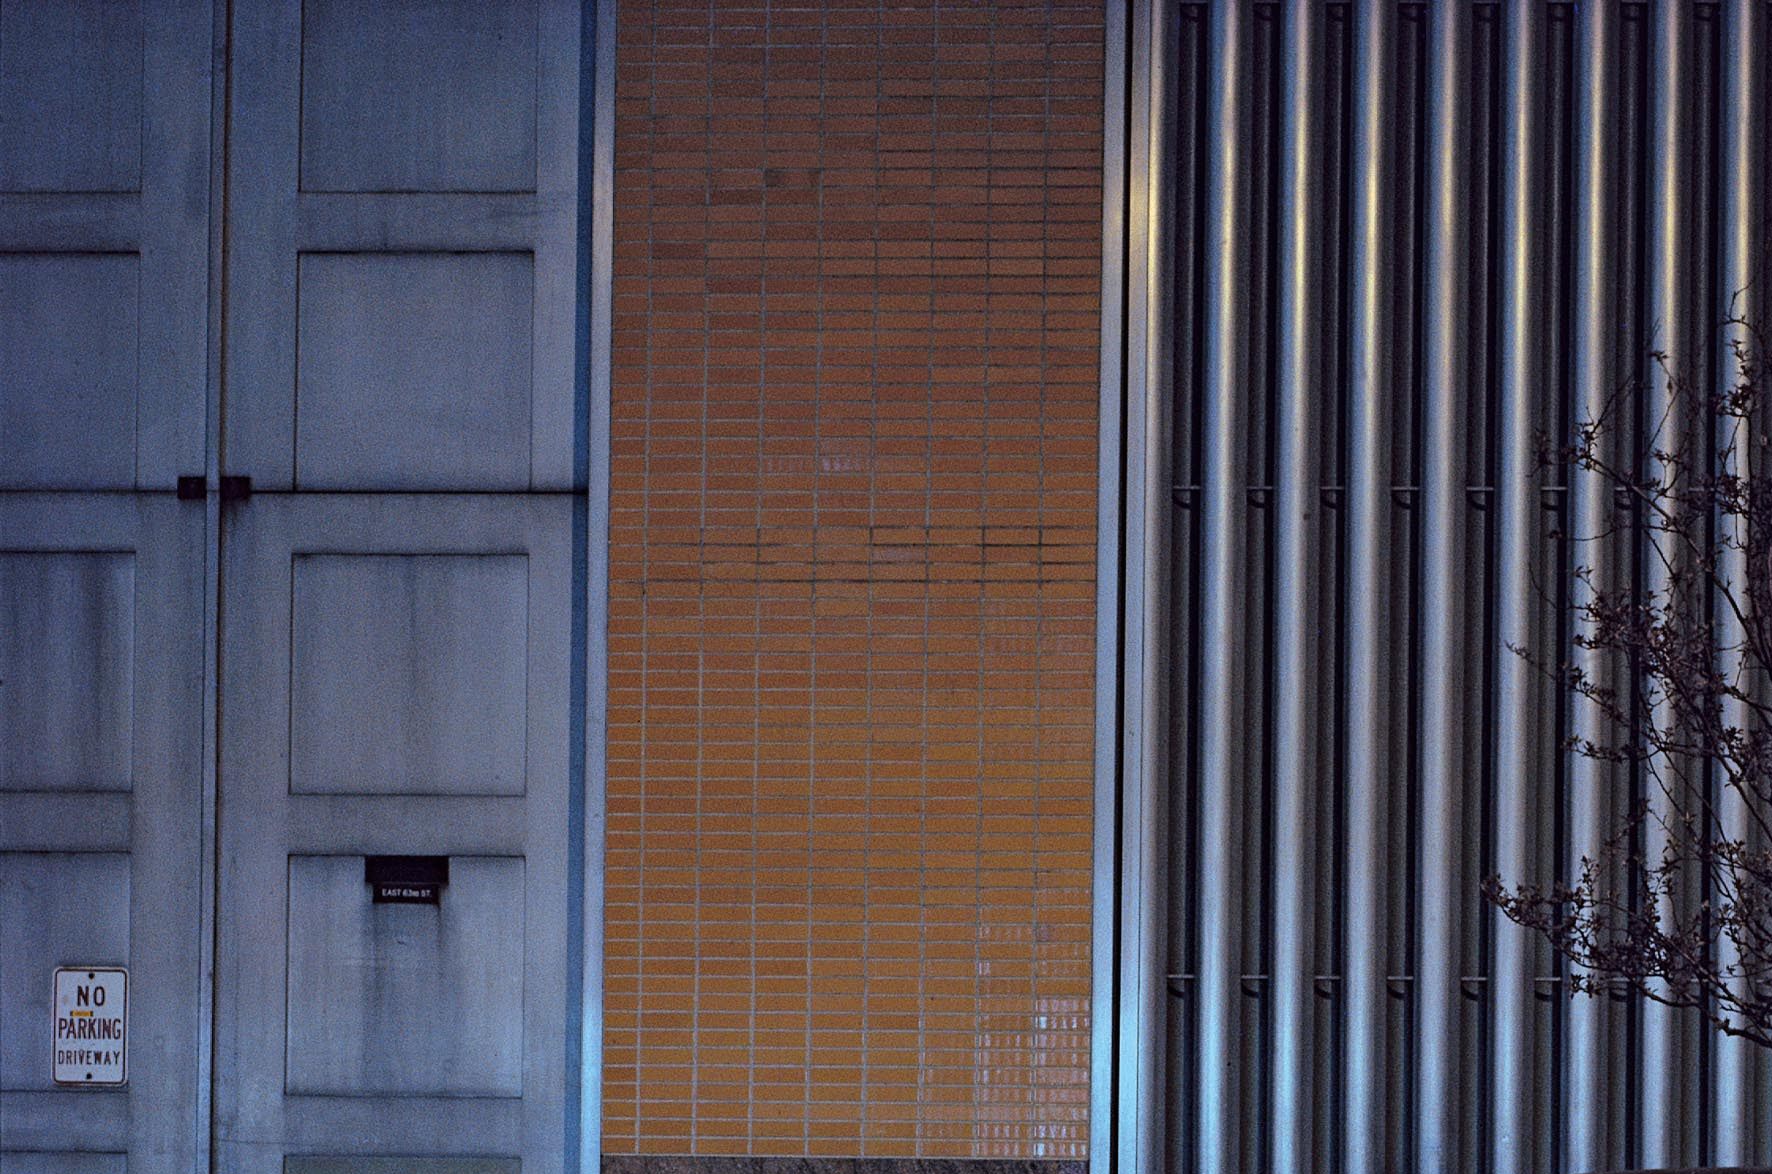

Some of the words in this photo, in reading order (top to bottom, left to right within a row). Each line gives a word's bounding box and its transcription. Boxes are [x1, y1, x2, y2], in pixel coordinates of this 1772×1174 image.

[382, 888, 401, 897] EAST
[77, 985, 106, 1007] NO
[58, 1018, 121, 1040] PARKING
[58, 1050, 120, 1065] DRIVEWAY
